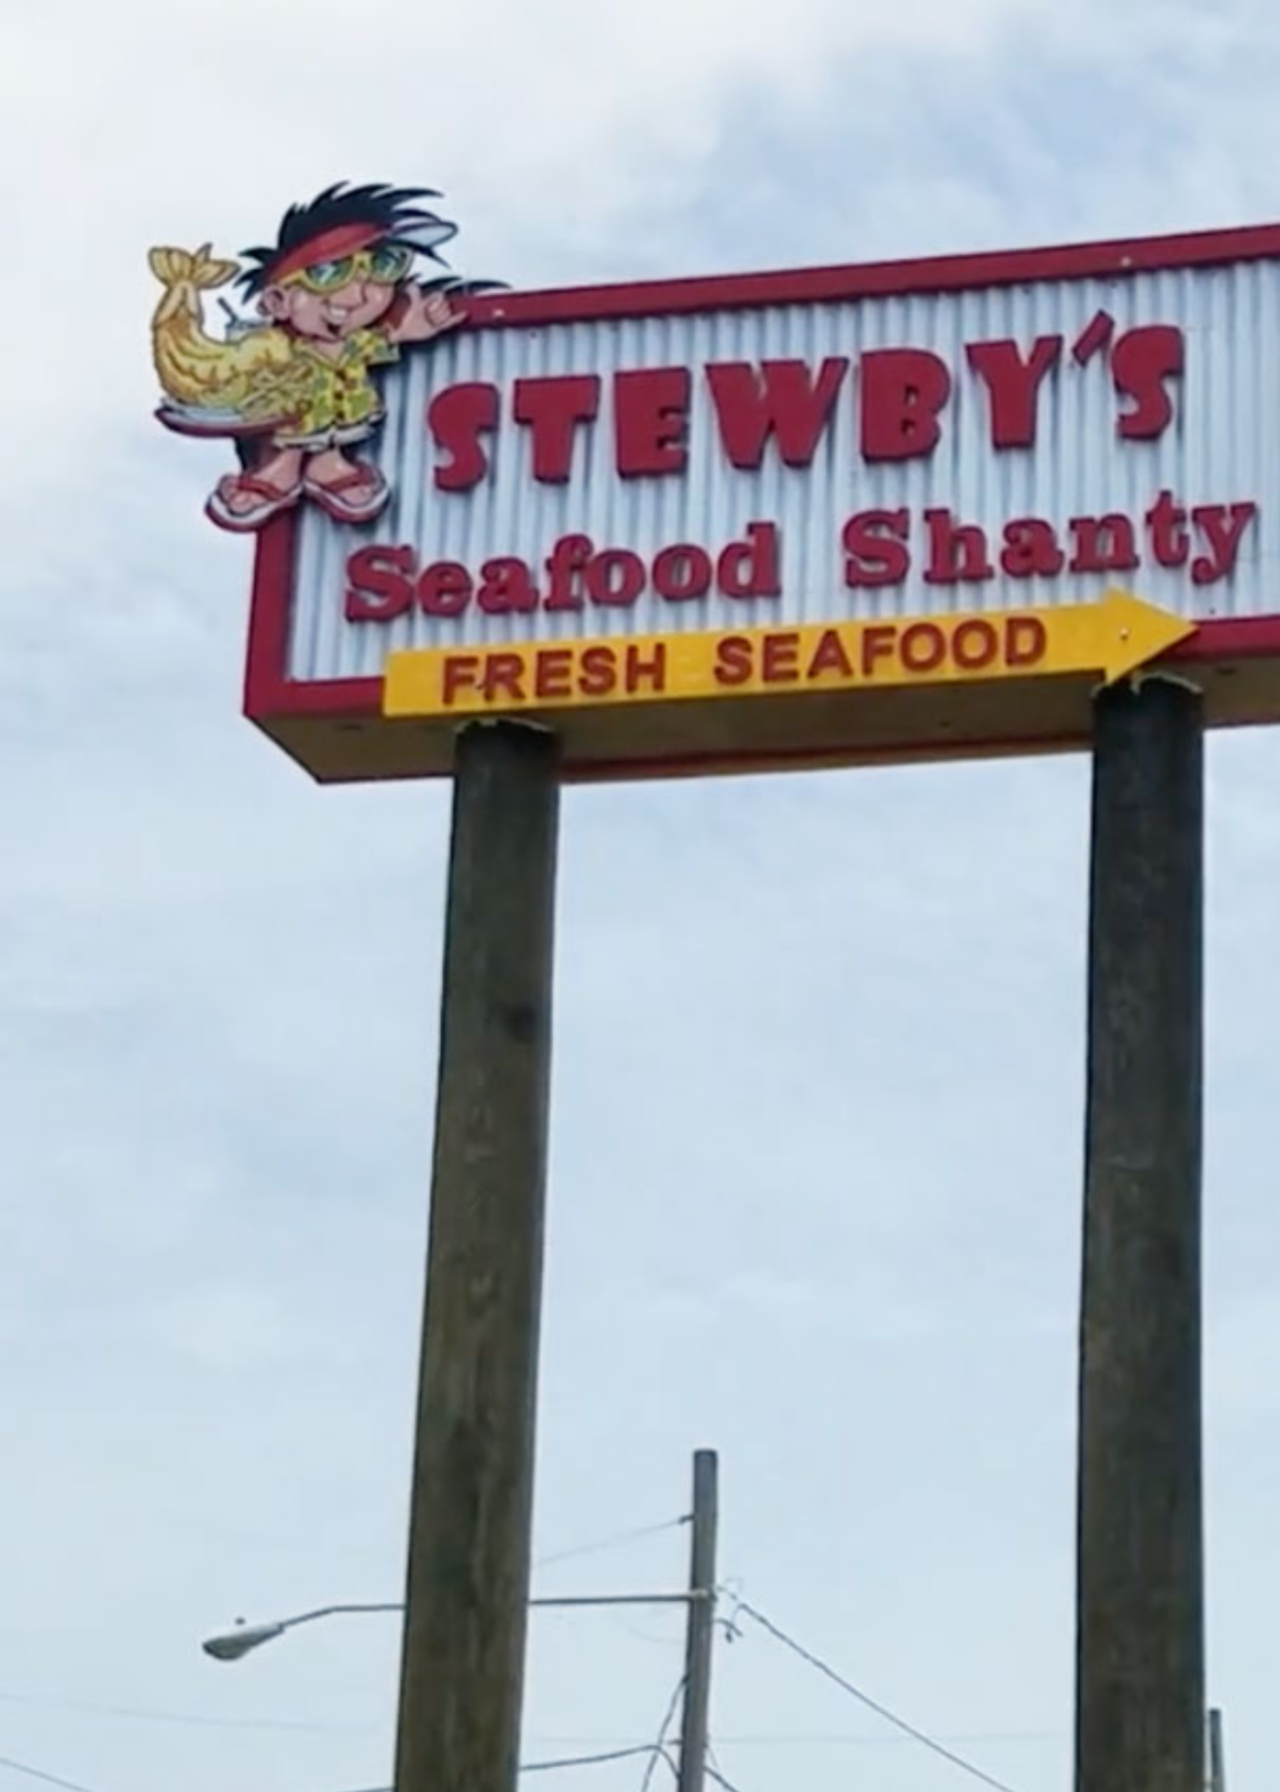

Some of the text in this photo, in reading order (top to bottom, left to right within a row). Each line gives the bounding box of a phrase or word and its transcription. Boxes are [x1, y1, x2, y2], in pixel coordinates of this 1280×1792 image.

[427, 310, 1184, 492] STEWBY'S
[344, 489, 1257, 623] Seafood Shanty
[441, 615, 1048, 706] FRESH SEAFOOD
